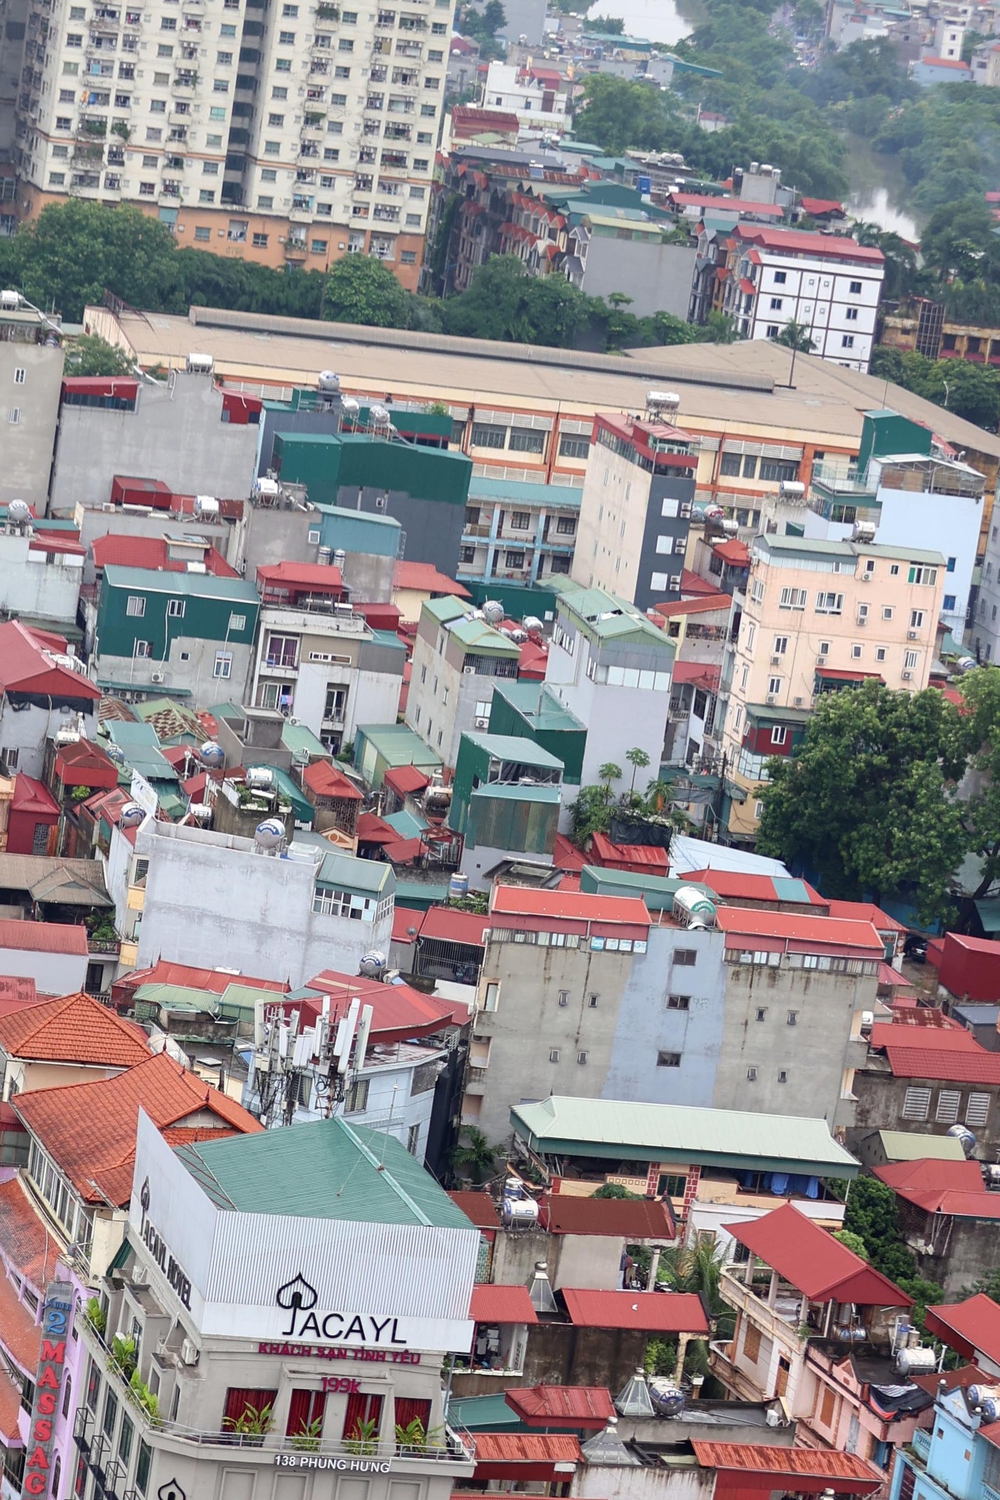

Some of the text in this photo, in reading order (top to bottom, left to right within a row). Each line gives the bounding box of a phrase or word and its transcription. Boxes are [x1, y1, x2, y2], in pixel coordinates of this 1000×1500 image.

[167, 1255, 191, 1311] HOTEL
[47, 1312, 66, 1335] 2
[281, 1293, 407, 1344] JACAYL
[258, 1341, 421, 1365] KHÁCH SẠN TÌNH YÊU
[320, 1377, 362, 1394] 199k
[275, 1455, 391, 1474] 138 PHÙNG HƯNG
